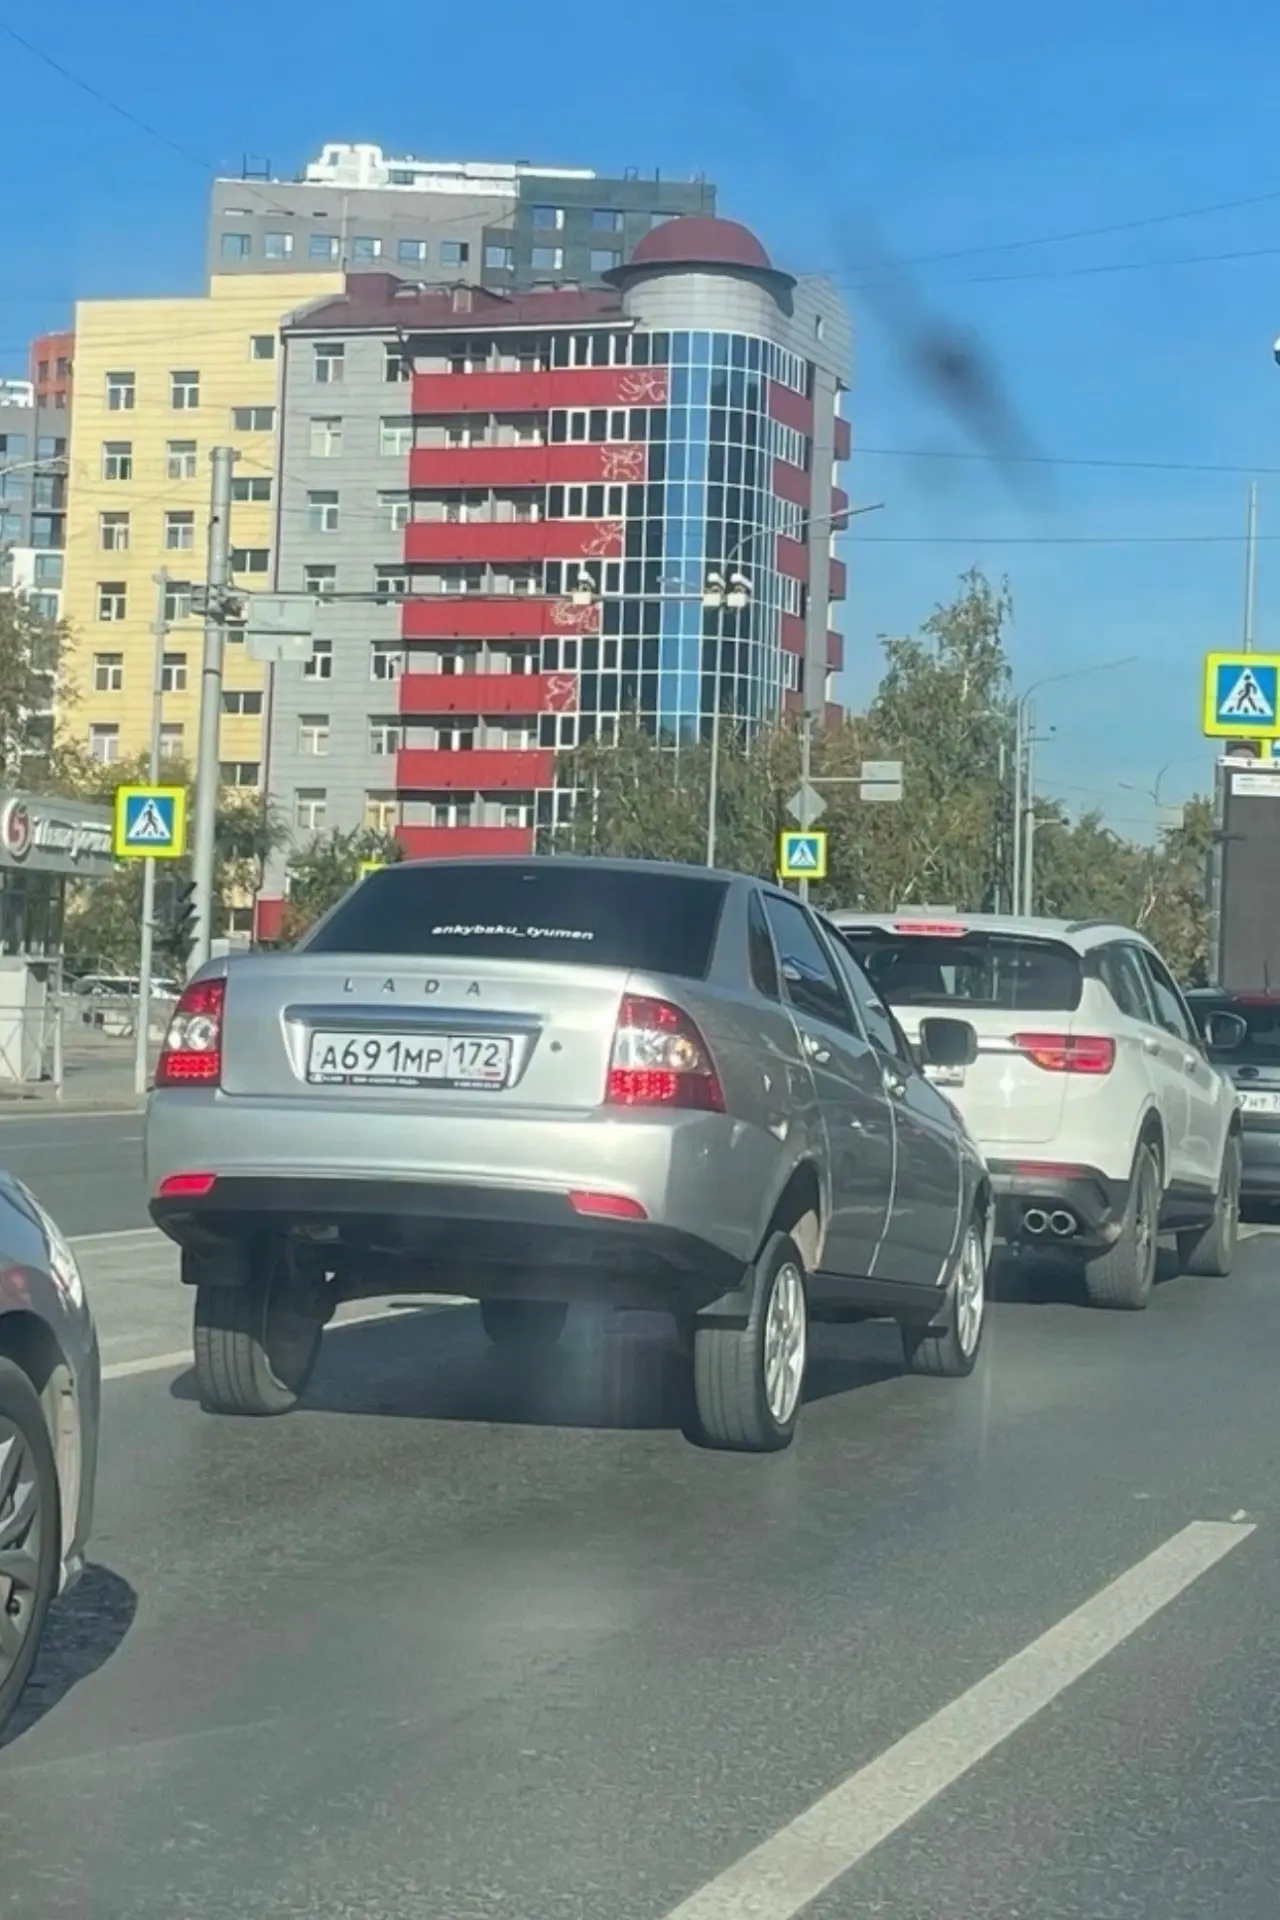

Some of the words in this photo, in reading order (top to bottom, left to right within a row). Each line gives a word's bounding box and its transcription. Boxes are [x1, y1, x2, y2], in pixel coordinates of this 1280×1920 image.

[343, 977, 482, 997] LADA
[320, 1039, 443, 1073] А691МР
[453, 1041, 500, 1067] 172
